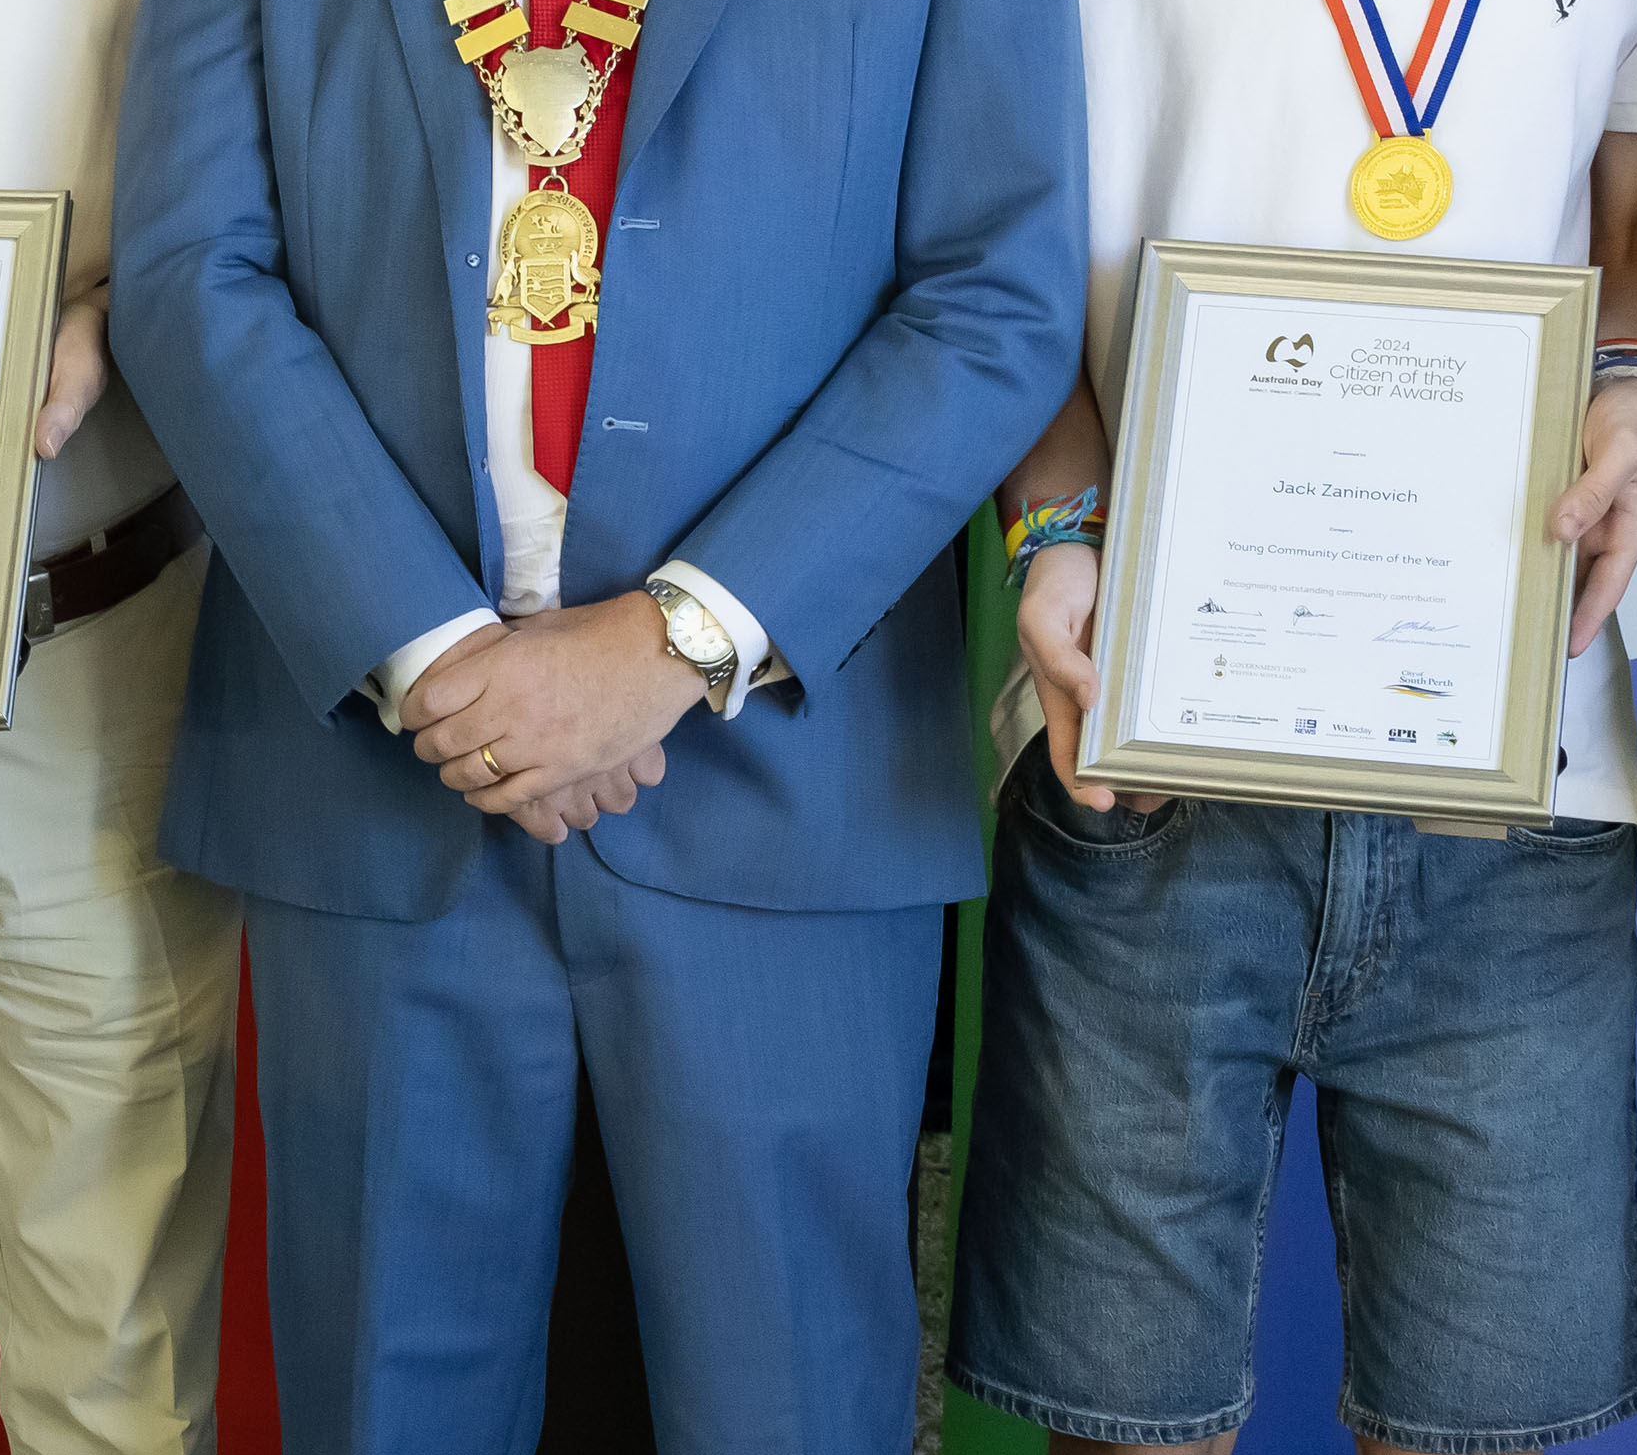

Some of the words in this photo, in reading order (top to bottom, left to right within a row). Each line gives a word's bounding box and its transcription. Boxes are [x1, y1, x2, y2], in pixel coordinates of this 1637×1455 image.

[1374, 338, 1410, 351] 2024
[1351, 348, 1467, 375] Community
[1250, 374, 1298, 386] Australia
[1302, 378, 1323, 388] Day
[1329, 365, 1393, 382] Citizen
[1399, 370, 1419, 384] of
[1424, 371, 1455, 387] the
[1340, 383, 1385, 399] year
[1390, 384, 1464, 402] Awards
[1273, 480, 1316, 496] Jack
[1321, 483, 1418, 503] Zaninovich
[1228, 541, 1264, 555] Young
[1267, 544, 1338, 561] Community
[1342, 550, 1383, 562] Citizen
[1387, 554, 1399, 563] of
[1402, 554, 1422, 565] the
[1426, 556, 1452, 567] Year
[1279, 583, 1334, 597] outstanding
[1337, 588, 1387, 601] community
[1390, 592, 1447, 604] contribution
[1400, 676, 1426, 685] South
[1428, 677, 1453, 687] Perth
[1332, 724, 1372, 735] WAtoday
[1388, 729, 1417, 738] 6PR
